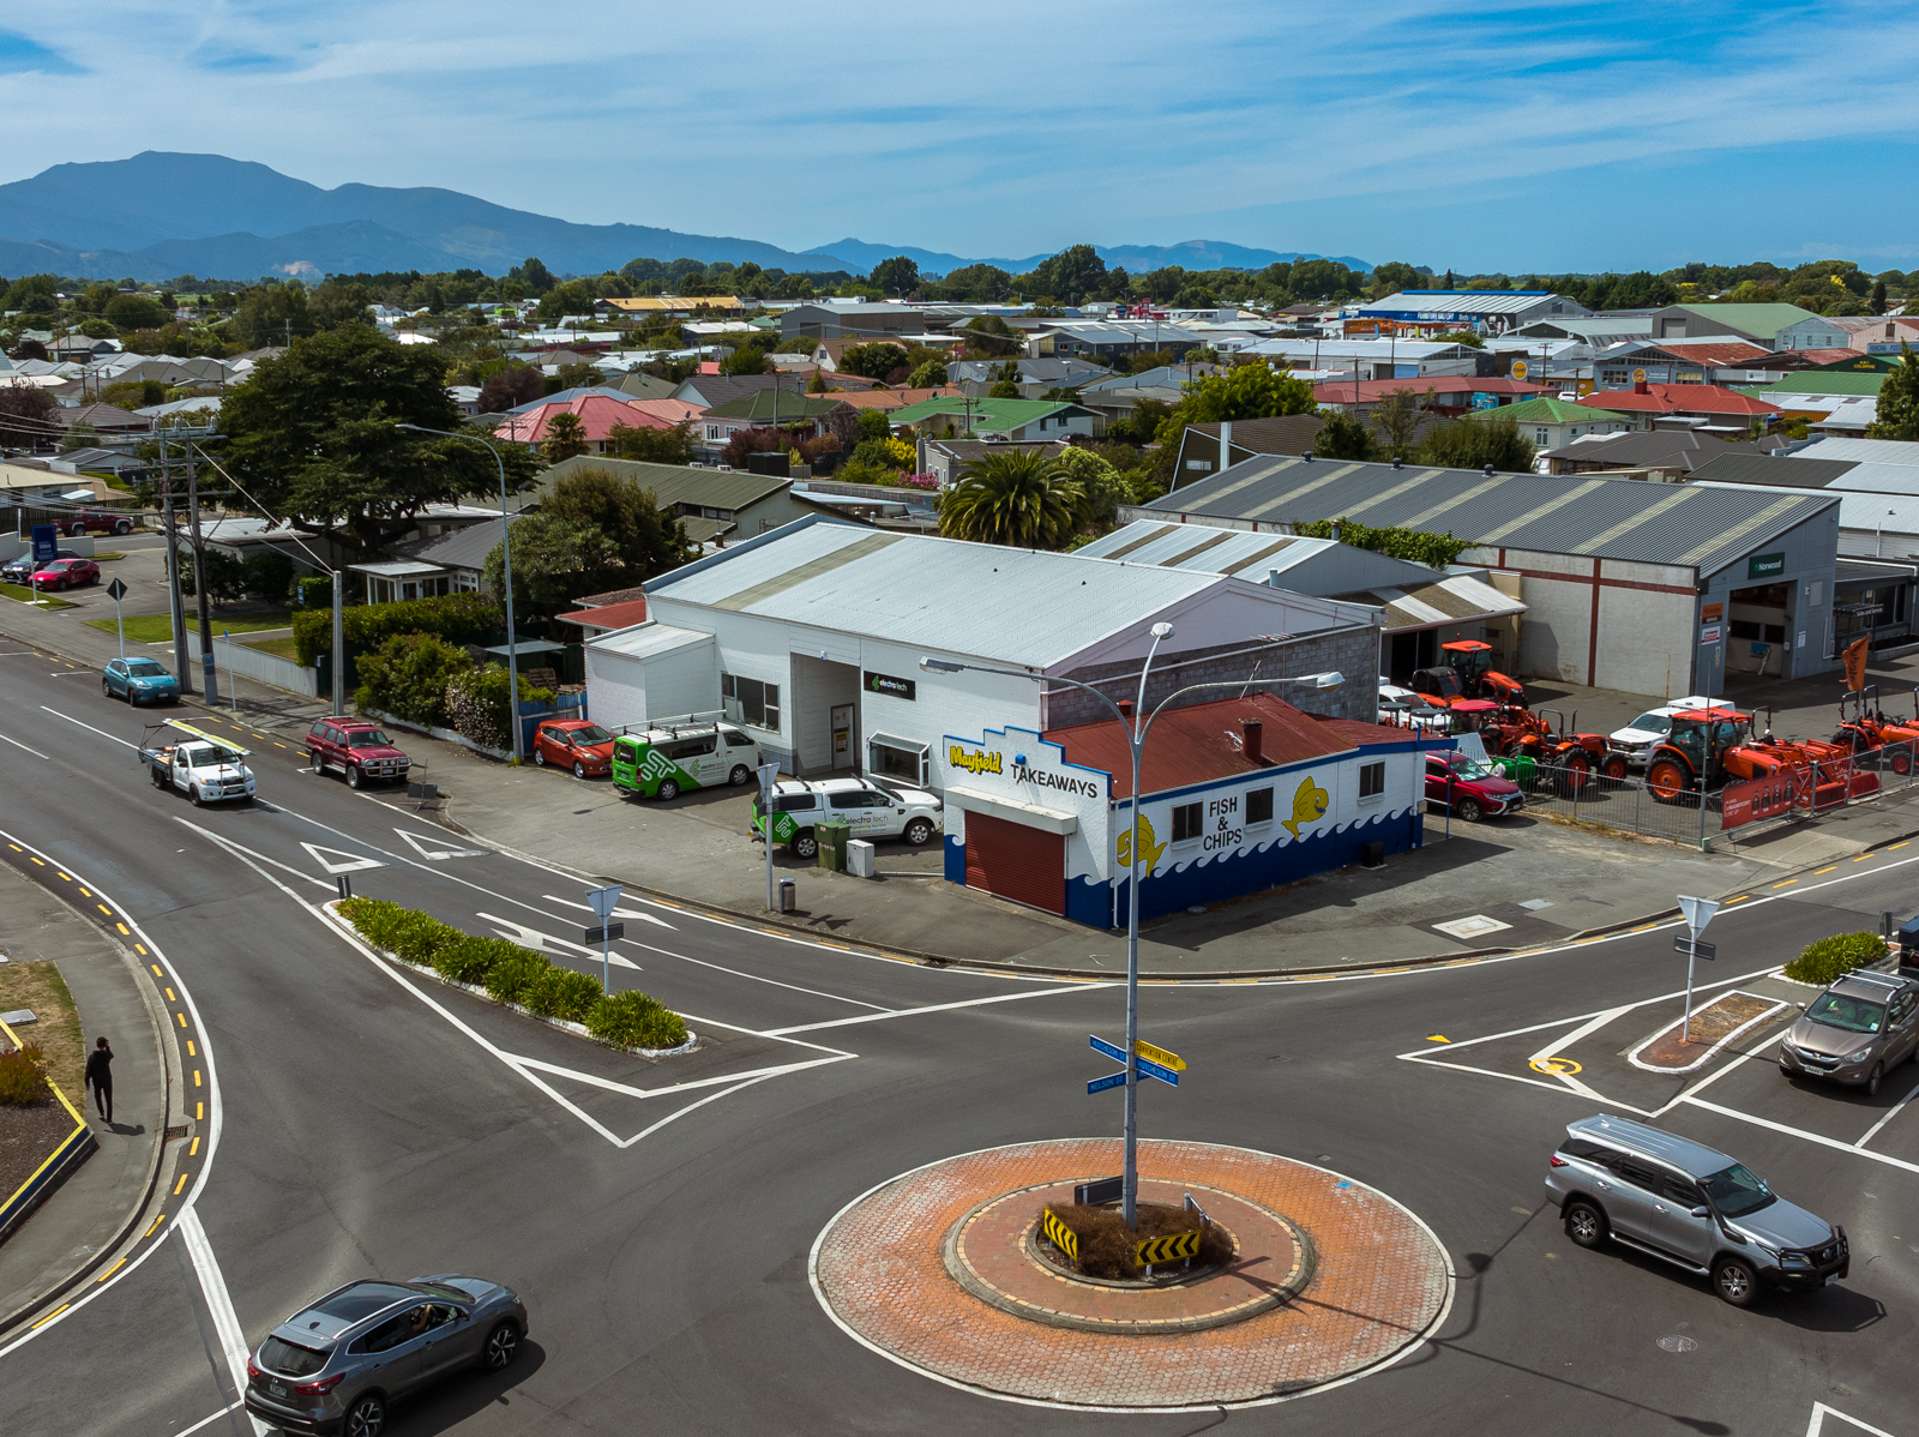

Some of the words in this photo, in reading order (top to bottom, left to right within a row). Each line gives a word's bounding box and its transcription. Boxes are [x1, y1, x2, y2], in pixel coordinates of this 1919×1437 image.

[949, 745, 1003, 775] Mayfield
[1010, 764, 1098, 798] TAKEAWAYS
[1209, 796, 1238, 817] FISH
[1217, 816, 1229, 831] &
[1203, 828, 1243, 851] CHIPS
